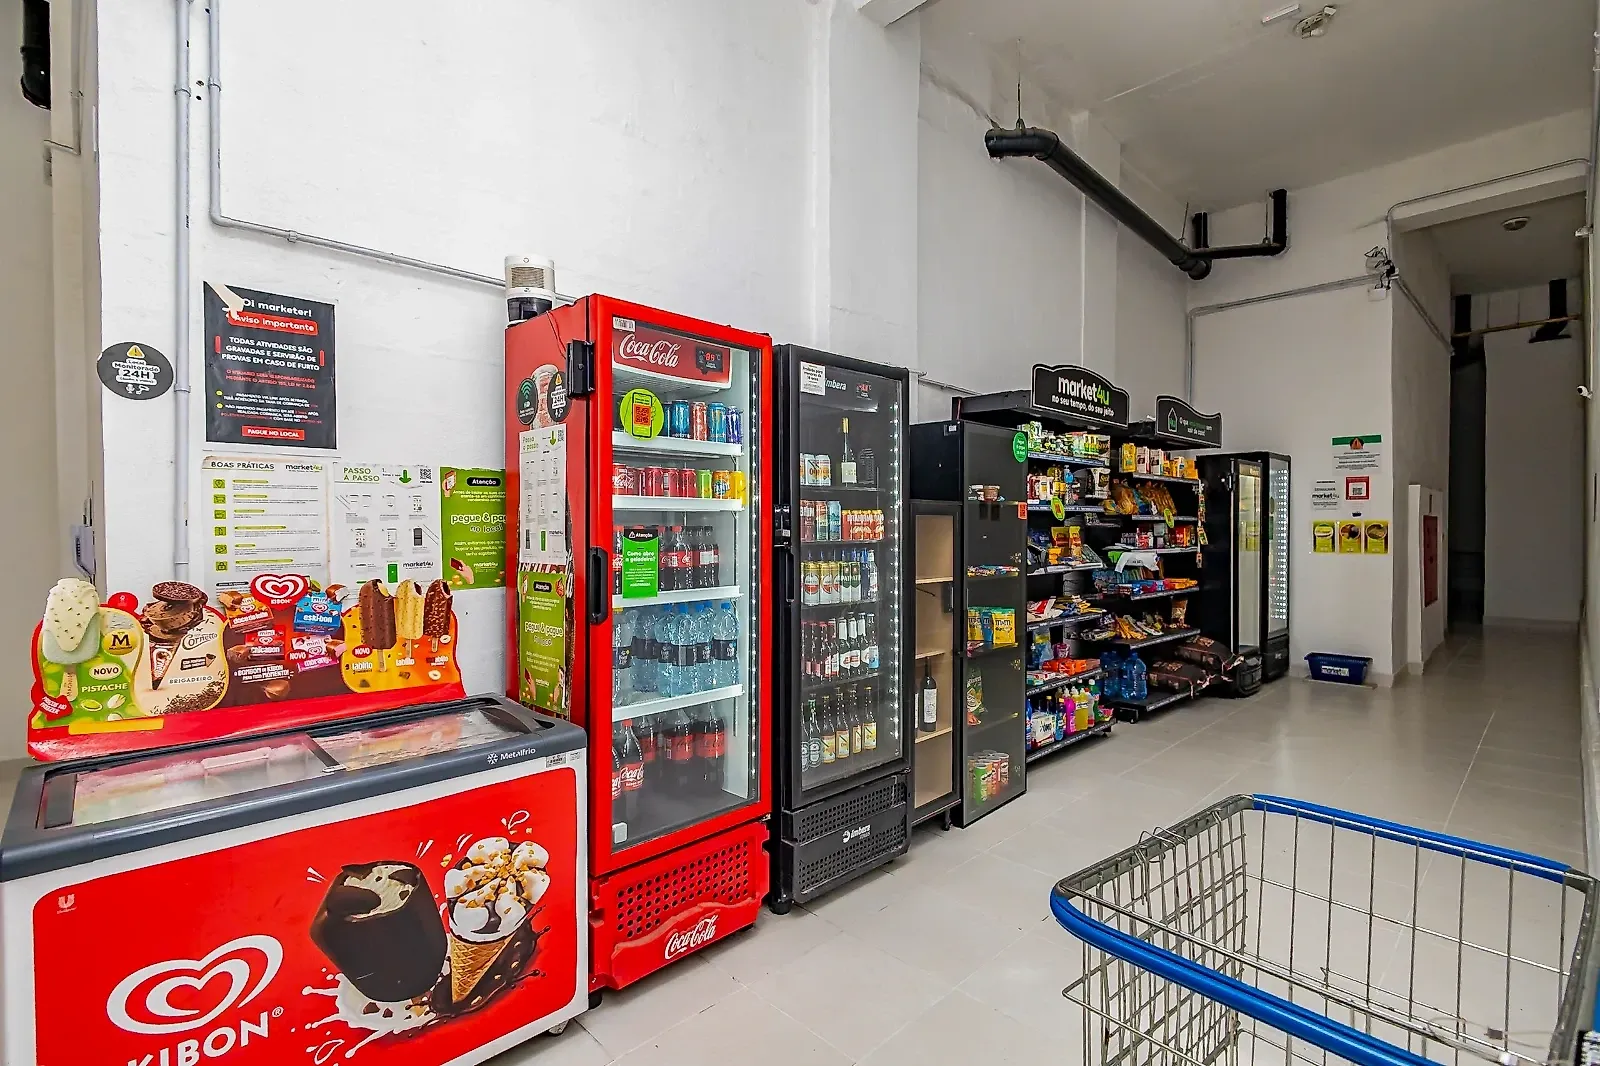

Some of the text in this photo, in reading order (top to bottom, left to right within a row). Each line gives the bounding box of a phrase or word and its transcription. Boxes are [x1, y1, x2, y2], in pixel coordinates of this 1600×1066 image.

[243, 298, 312, 318] Oi marketer!
[235, 315, 314, 332] Aviso importante
[229, 336, 312, 354] TODAS ATIVIDADES SÃO
[619, 334, 682, 368] Coca-Cola
[226, 346, 265, 356] GRAVADAS
[272, 351, 306, 360] SERVIRÃO
[115, 362, 158, 372] Monitorado
[222, 354, 252, 363] PROVAS
[298, 363, 320, 371] FURTO
[123, 370, 150, 379] 24H
[1058, 376, 1110, 406] market4u
[1052, 395, 1059, 403] no
[1060, 396, 1069, 405] seu
[1070, 398, 1087, 411] tempo,
[1088, 402, 1095, 410] do
[1103, 407, 1115, 417] jeito
[450, 514, 480, 524] pegue
[482, 512, 490, 522] &
[483, 524, 503, 533] local
[303, 614, 332, 623] eski-bon
[111, 634, 131, 646] M
[182, 632, 218, 650] Cornetto
[290, 651, 306, 660] NOVO
[93, 667, 119, 675] NOVO
[170, 676, 212, 684] BRIGADEIRO
[81, 683, 128, 693] PISTACHE
[500, 748, 536, 761] Metalfrio
[665, 915, 718, 960] Coca-Cola
[127, 1011, 269, 1066] IBON
